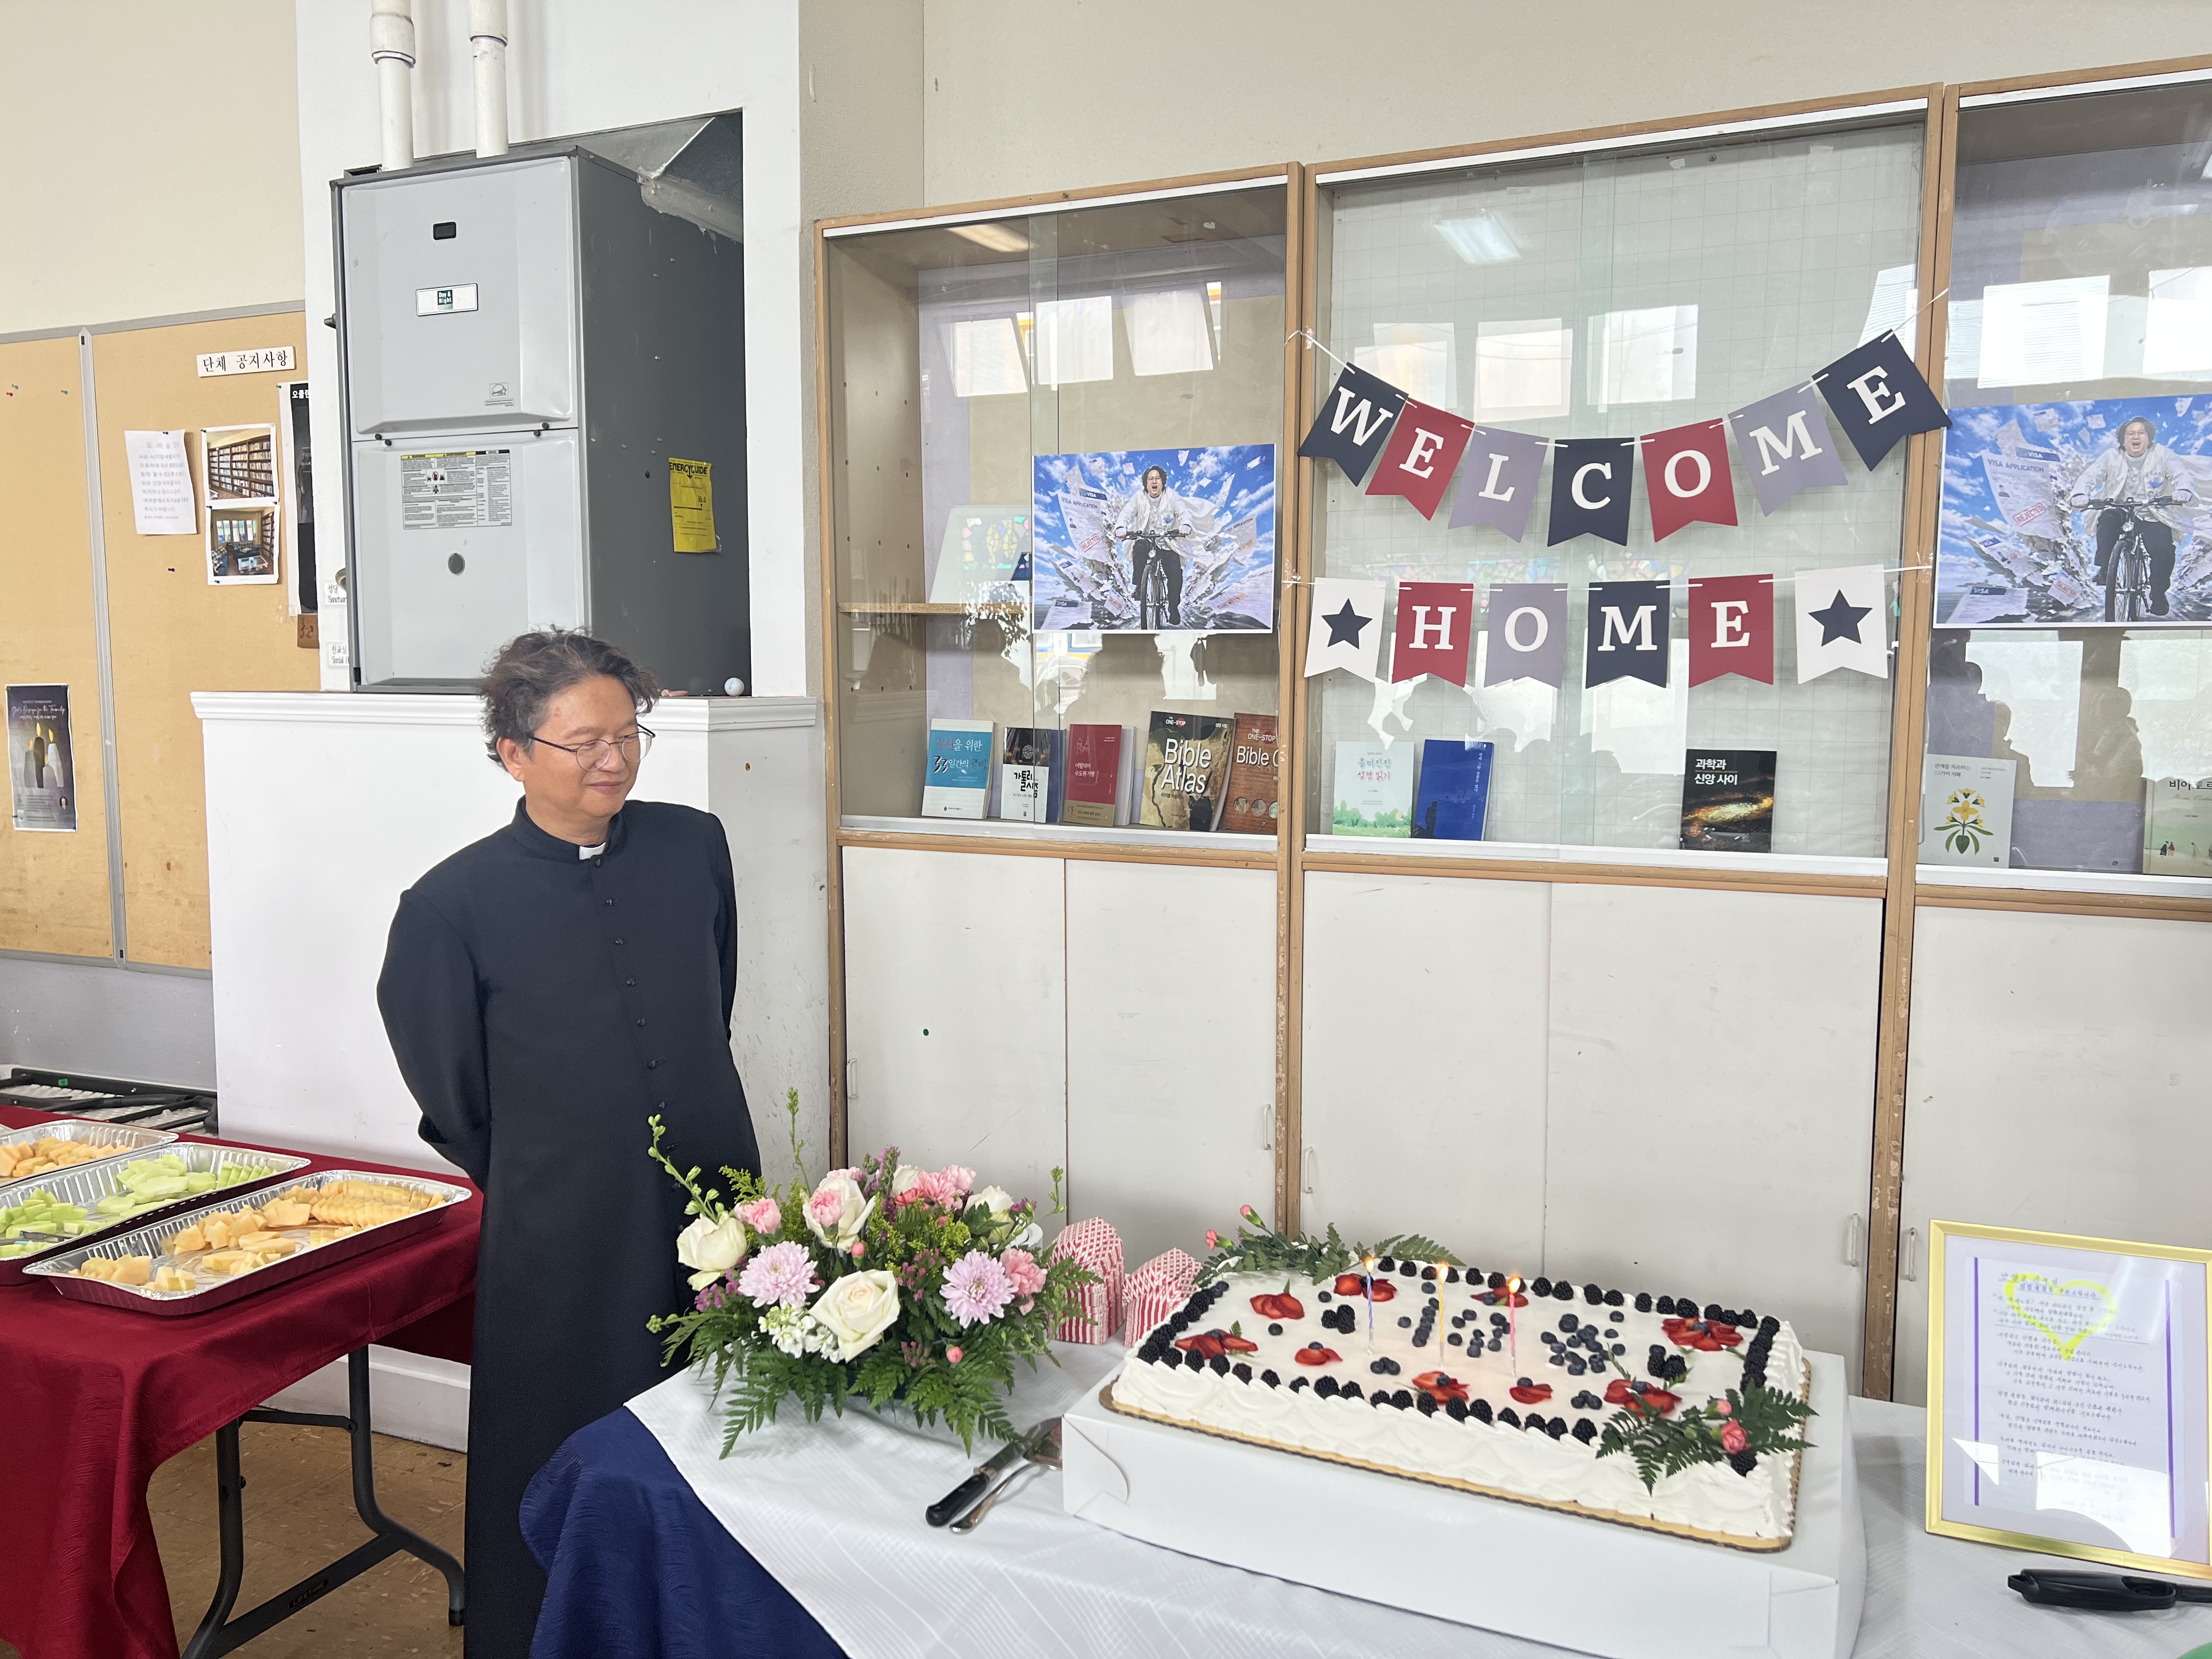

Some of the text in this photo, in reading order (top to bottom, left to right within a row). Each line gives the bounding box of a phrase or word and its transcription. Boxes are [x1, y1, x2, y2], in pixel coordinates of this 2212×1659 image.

[203, 351, 288, 372] 단체 공지사항
[1331, 366, 1906, 511] WELCOME
[669, 462, 708, 476] ENERGYGUIDE
[1987, 459, 2044, 472] VISA APPLICATION
[1073, 500, 1098, 509] APPLICATION
[2016, 505, 2044, 524] REJECTED
[1234, 517, 1254, 528] APPLICATION
[1081, 535, 1099, 550] REJECTED
[2058, 582, 2076, 596] REJECTED
[1409, 601, 1750, 653] HOME
[1248, 732, 1276, 742] ONE-STOP
[964, 739, 983, 752] 위한
[1164, 738, 1212, 769] Bible
[1237, 746, 1269, 766] Bible
[1358, 757, 1391, 768] 흥미진진
[1695, 758, 1727, 770] 과학과
[1160, 764, 1206, 794] Atlas
[1357, 770, 1390, 781] 성경 읽기
[1694, 774, 1738, 786] 신앙 사이
